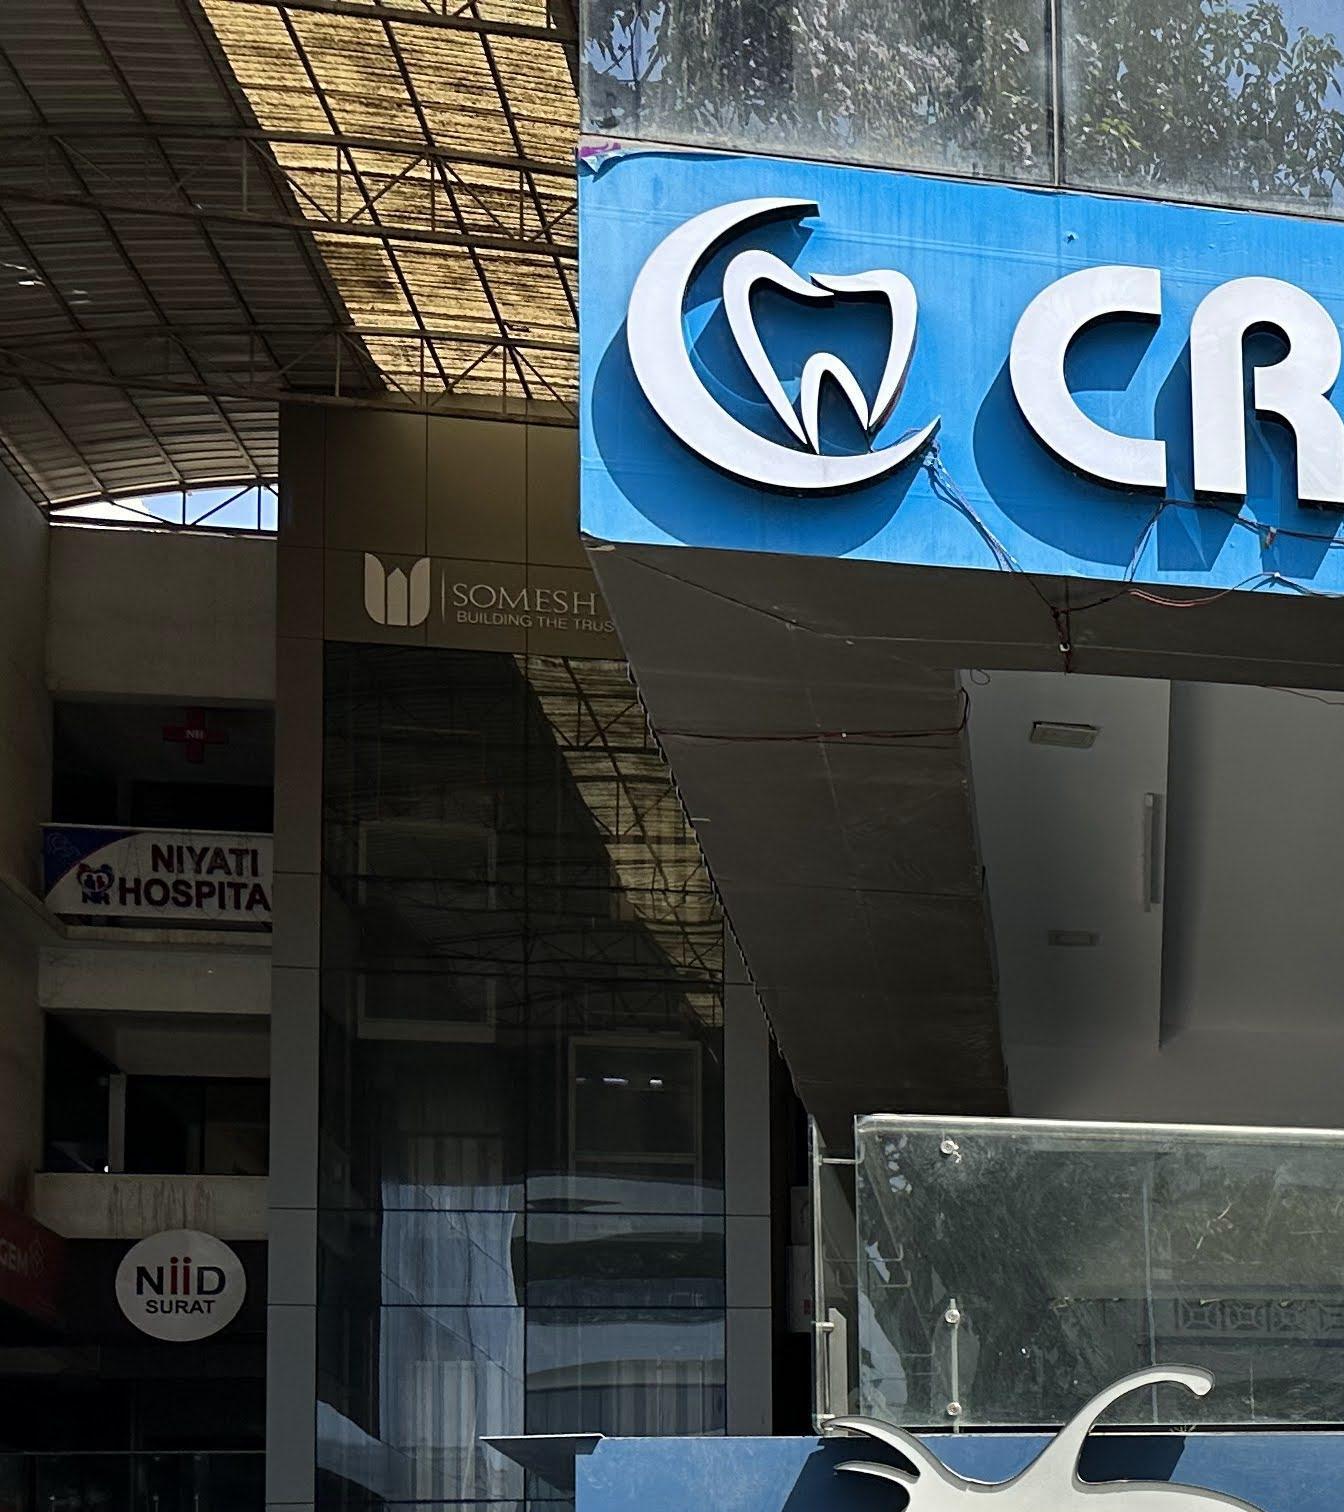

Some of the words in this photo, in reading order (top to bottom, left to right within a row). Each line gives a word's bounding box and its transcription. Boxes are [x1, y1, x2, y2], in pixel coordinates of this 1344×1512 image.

[452, 582, 597, 616] SOMESH
[456, 610, 533, 628] BUILDING
[537, 616, 568, 630] THE
[572, 617, 615, 633] TRUS
[151, 844, 259, 877] NIYATI
[118, 877, 272, 912] HOSPITA
[146, 1300, 216, 1314] SURAT
